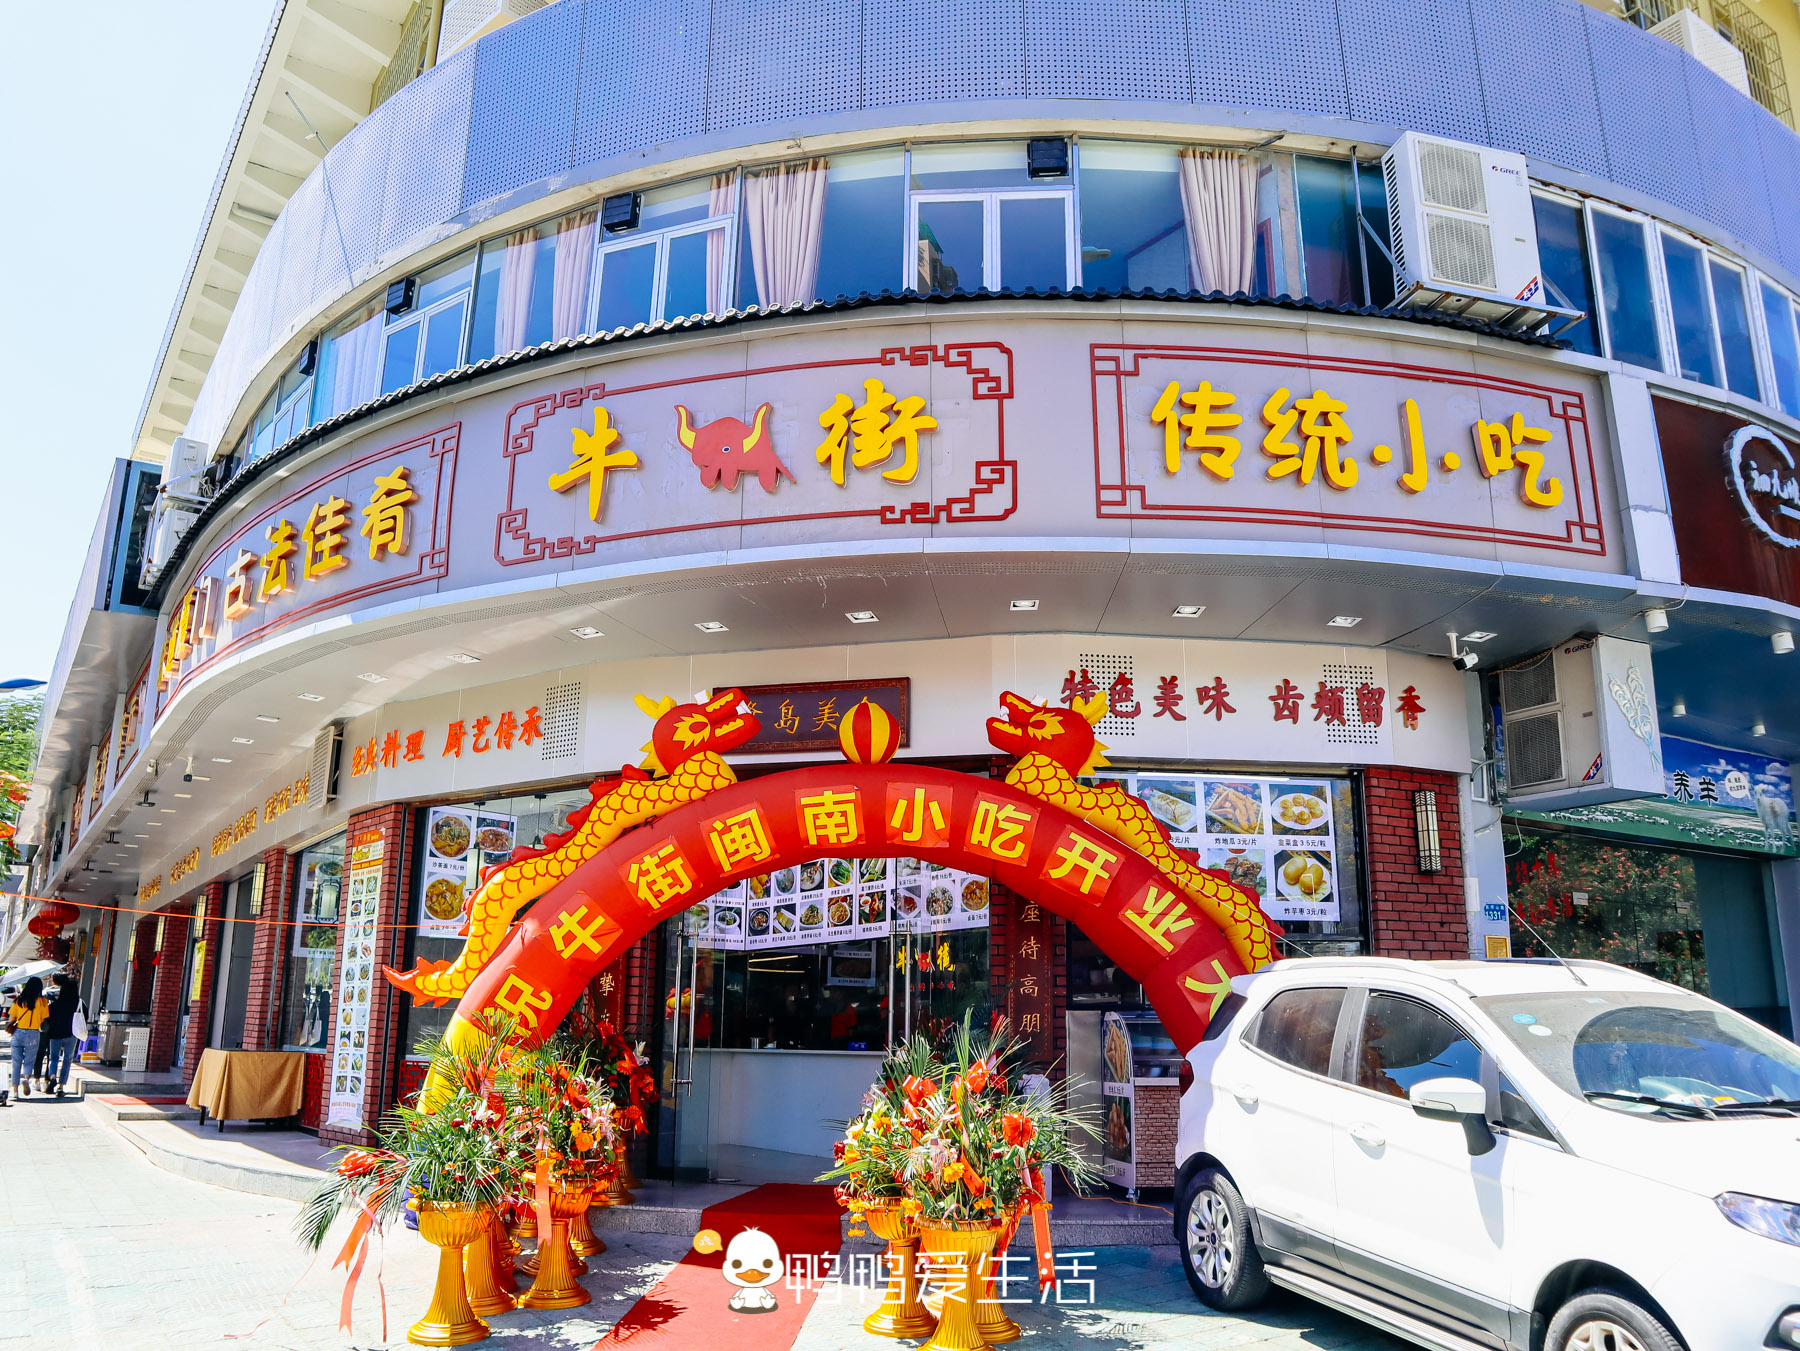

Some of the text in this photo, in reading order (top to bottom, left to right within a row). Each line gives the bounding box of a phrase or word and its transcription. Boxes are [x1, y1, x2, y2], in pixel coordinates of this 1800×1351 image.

[1151, 380, 1563, 508] 传统小吃
[1061, 669, 1427, 731] 特色美味 齿颊留香
[351, 706, 544, 778] 经典料理 厨艺传承
[1660, 769, 1719, 807] 养羊
[1214, 837, 1258, 846] 炸地瓜 3元/片
[1278, 838, 1327, 847] 韭菜盒 3.5元/粒
[1283, 907, 1328, 916] 炸芋枣 3元/粒
